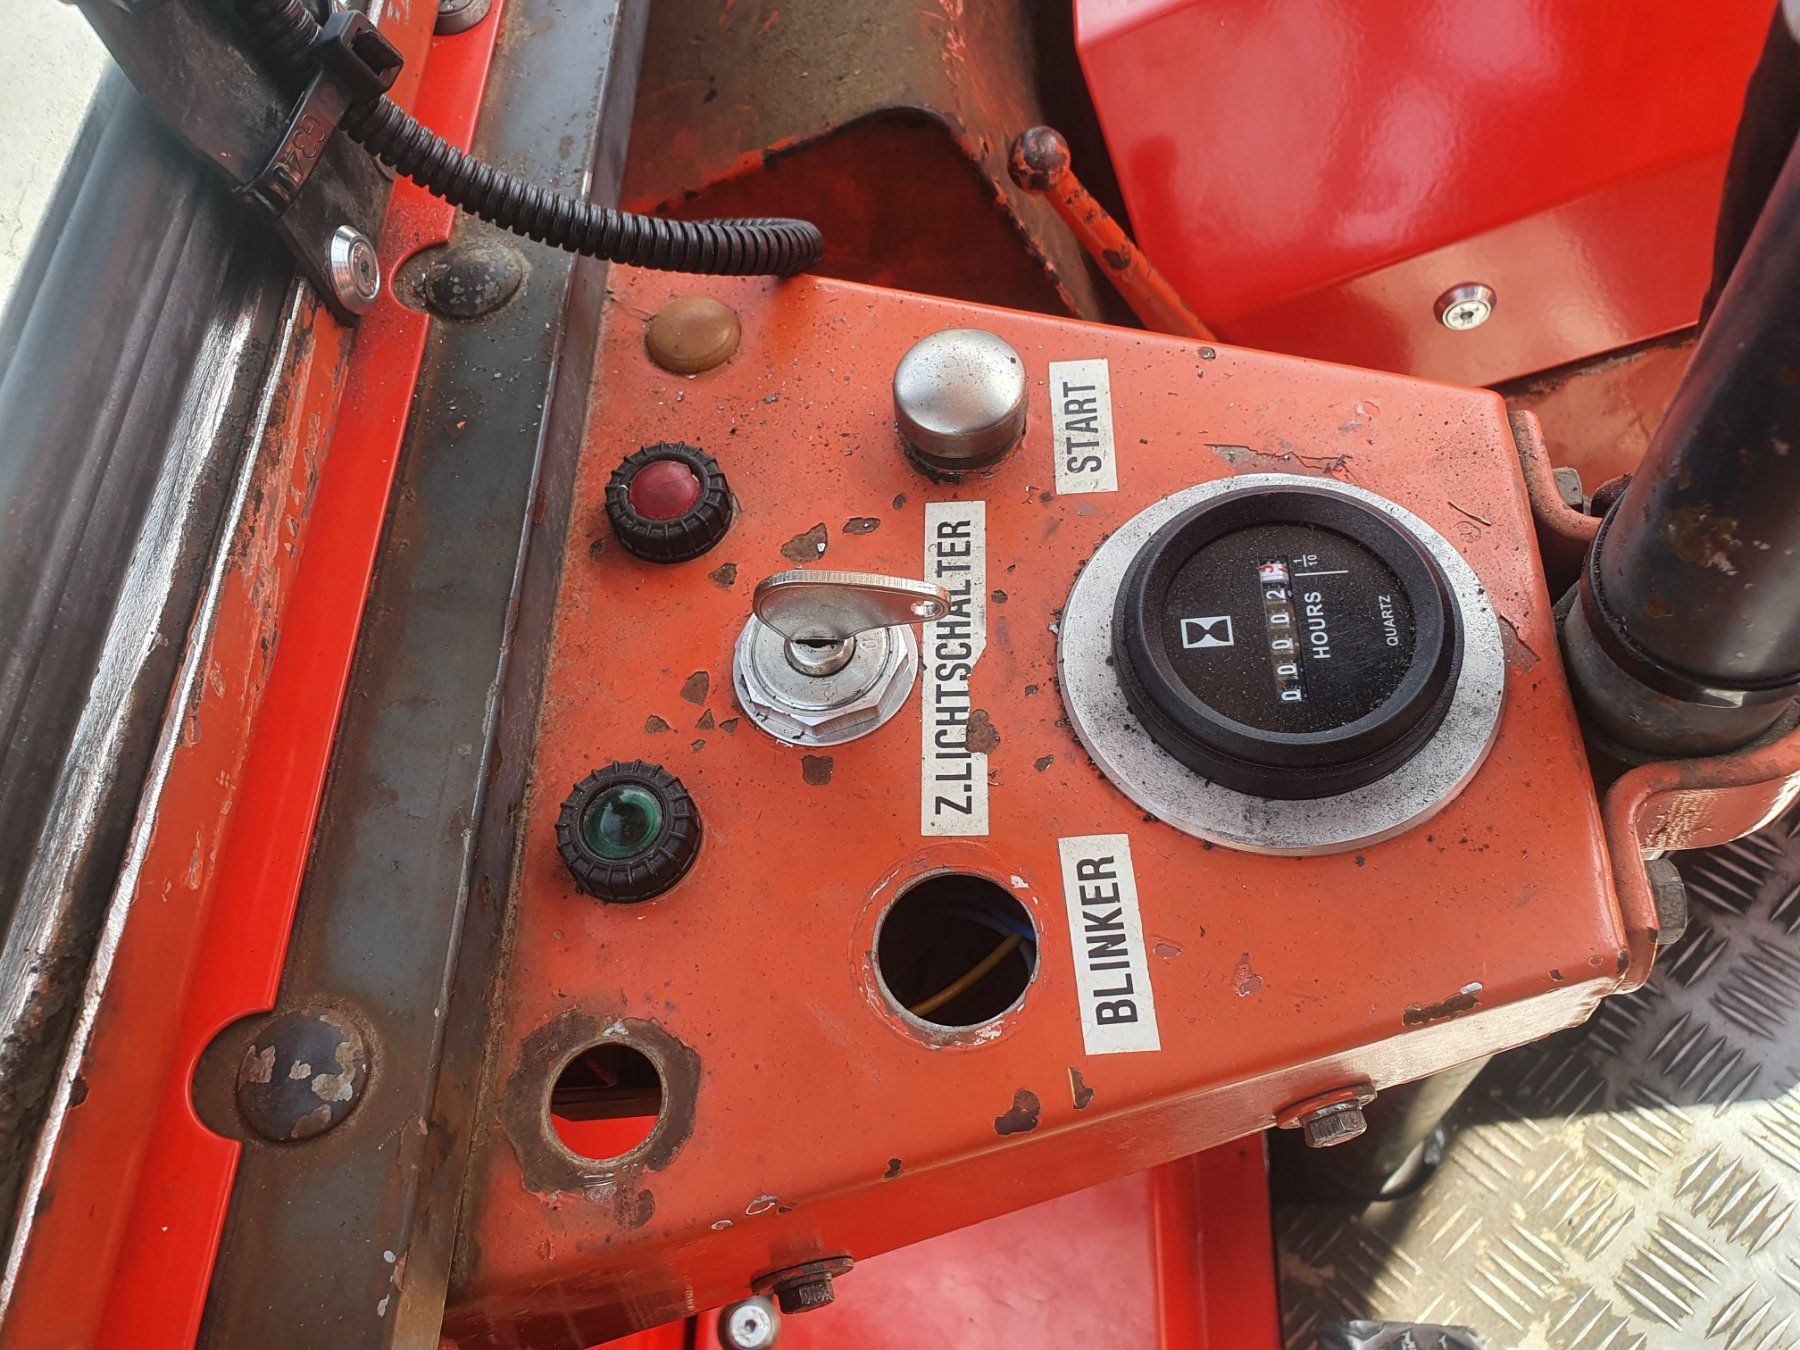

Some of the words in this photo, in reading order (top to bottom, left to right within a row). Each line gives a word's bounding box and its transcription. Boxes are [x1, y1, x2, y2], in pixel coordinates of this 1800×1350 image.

[1062, 380, 1102, 474] START
[935, 519, 972, 816] Z.LICHTSCHALTER
[1304, 590, 1331, 660] HOURS
[1377, 594, 1399, 647] QUARTZ
[1076, 854, 1139, 1026] BLINKER
